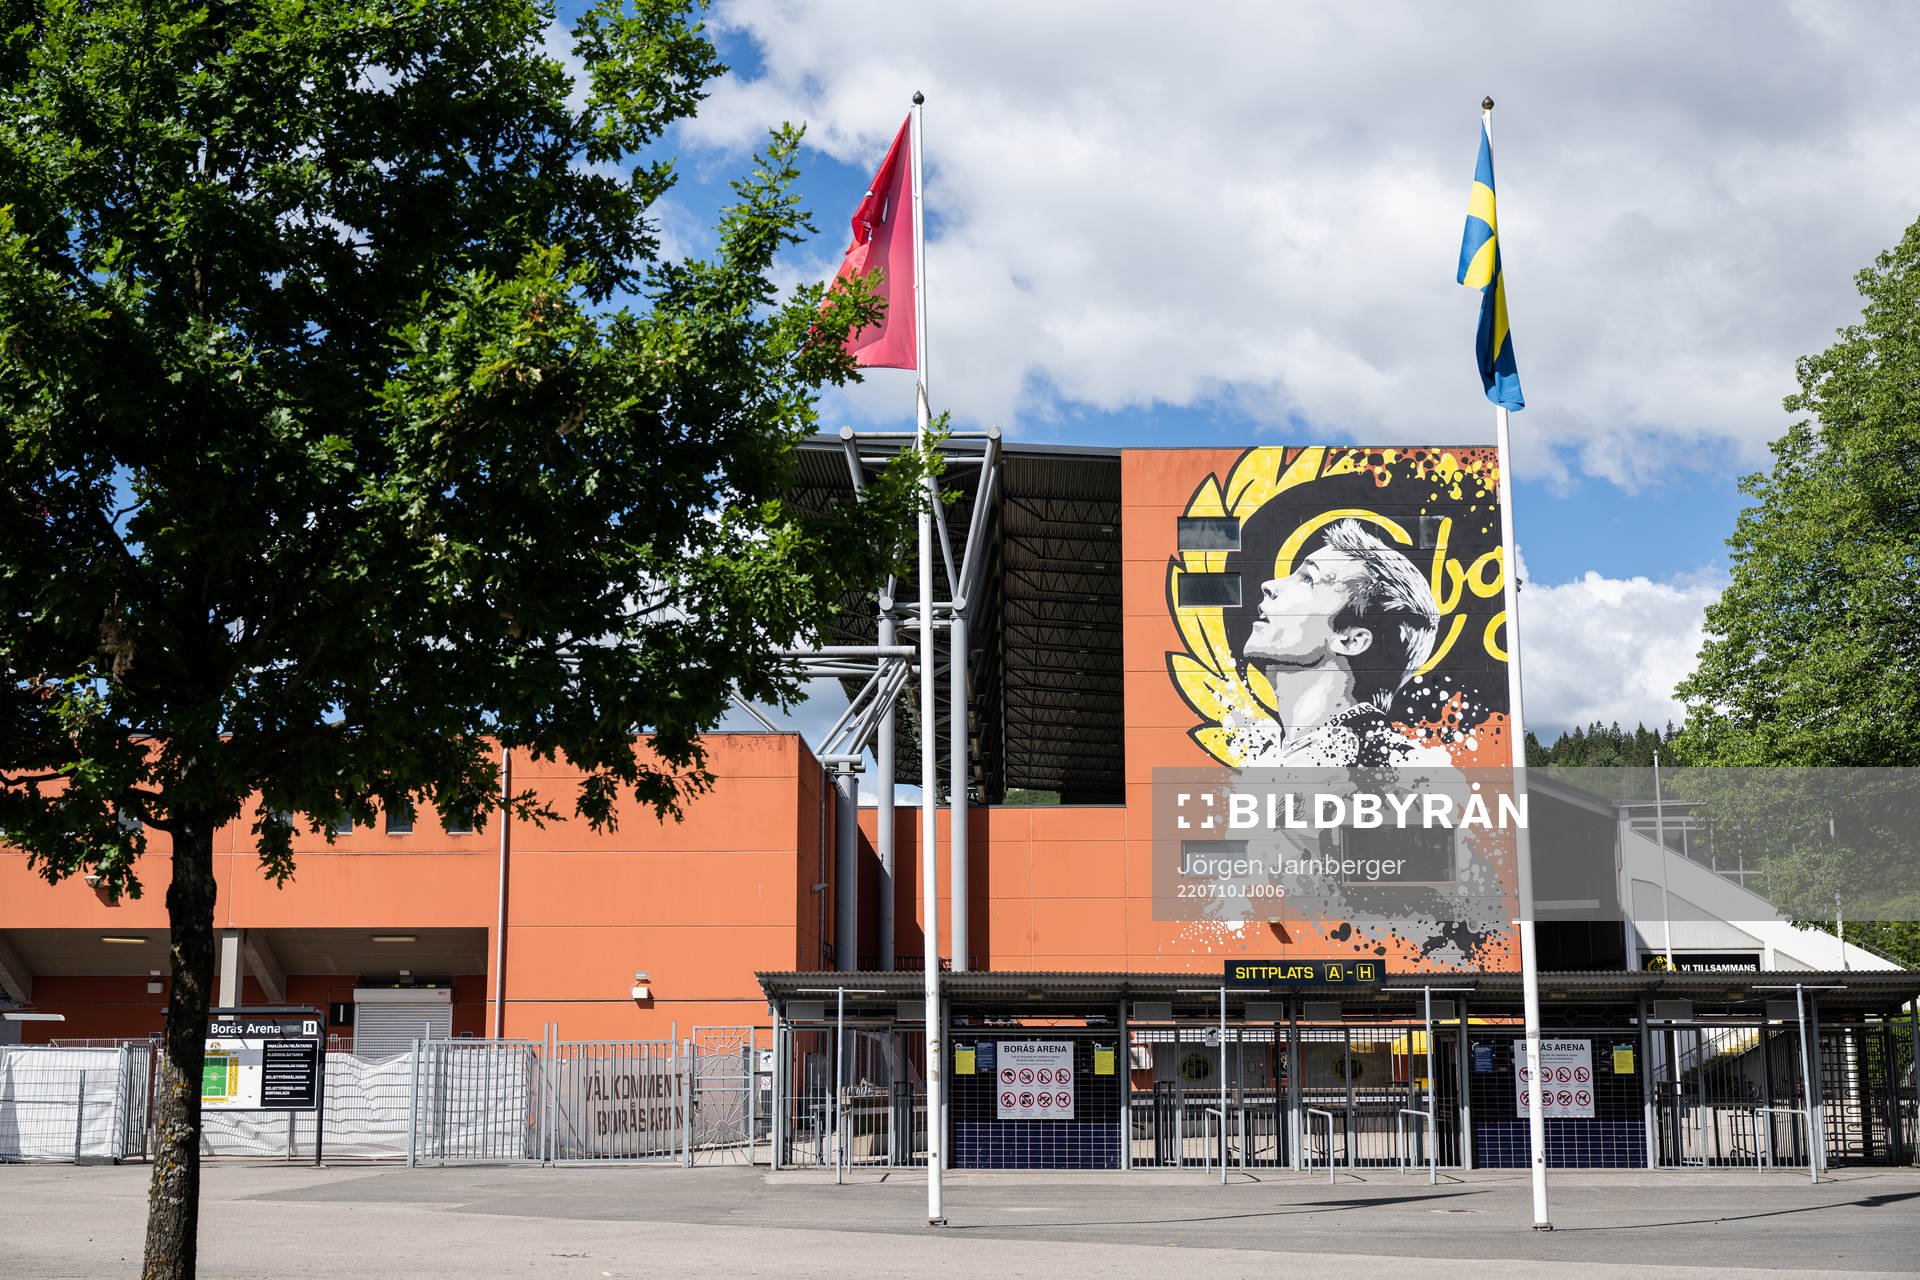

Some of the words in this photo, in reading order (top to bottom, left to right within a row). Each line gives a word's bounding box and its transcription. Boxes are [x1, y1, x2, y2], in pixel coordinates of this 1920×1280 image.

[1235, 966, 1314, 979] SITTPLATS
[1681, 964, 1691, 972] VI
[1692, 964, 1757, 972] TILLSAMMANS
[211, 1022, 243, 1034] Borås
[246, 1023, 281, 1034] Arena
[1003, 1043, 1035, 1053] BORÅS
[1036, 1045, 1067, 1053] ARENA
[1521, 1042, 1553, 1051] BÅS
[1554, 1043, 1585, 1051] ARENA
